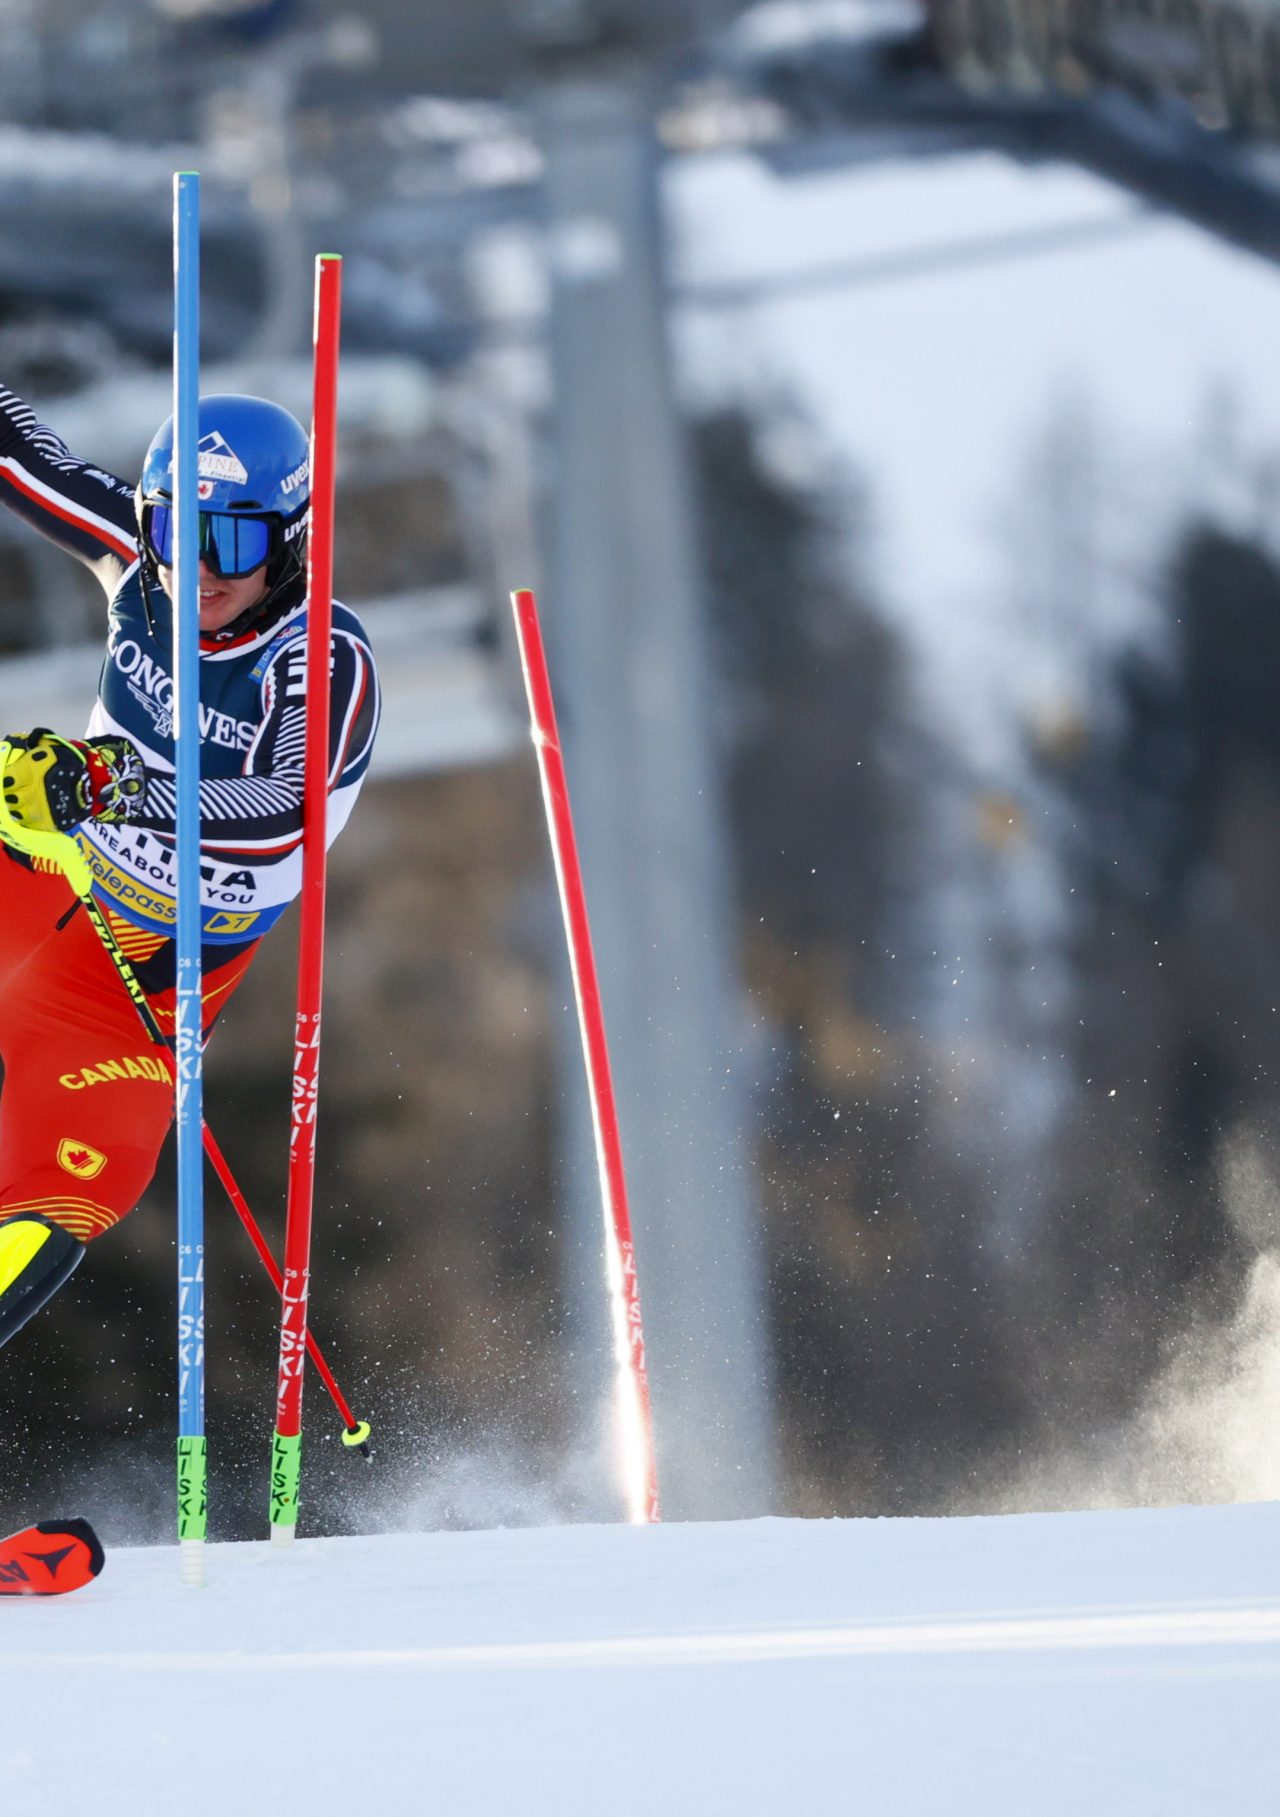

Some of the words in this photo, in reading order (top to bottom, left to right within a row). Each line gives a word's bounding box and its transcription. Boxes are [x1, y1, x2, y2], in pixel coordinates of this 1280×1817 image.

[284, 509, 309, 542] uve
[107, 618, 260, 752] LONGNES
[86, 850, 178, 920] Telepass
[111, 949, 146, 1004] LEKI
[58, 1056, 173, 1090] CANADA
[290, 1023, 308, 1146] LISKI
[272, 1437, 288, 1523] LISKI
